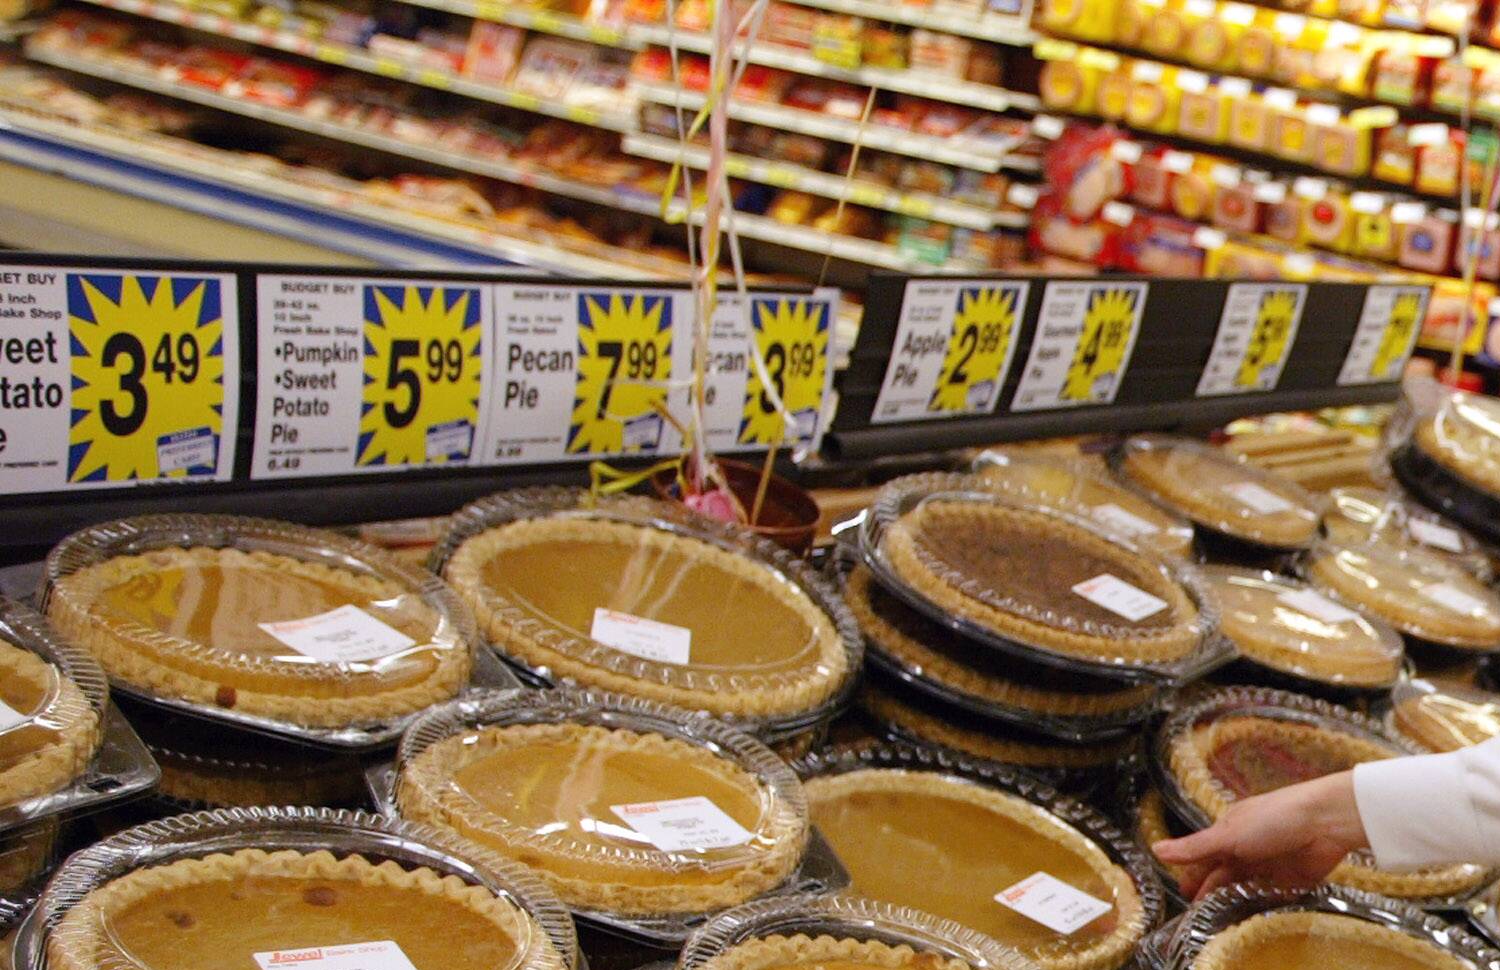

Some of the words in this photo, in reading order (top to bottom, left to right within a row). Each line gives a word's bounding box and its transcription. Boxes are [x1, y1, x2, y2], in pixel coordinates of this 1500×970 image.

[27, 273, 57, 286] BUY
[280, 281, 328, 293] BUDGET
[30, 308, 62, 321] Shop
[902, 328, 947, 360] Apple
[508, 343, 573, 372] Pecan
[890, 364, 919, 387] Pie
[504, 381, 539, 409] Pie
[273, 397, 330, 417] Potato
[271, 424, 299, 443] Pie
[269, 948, 324, 964] Jewel
